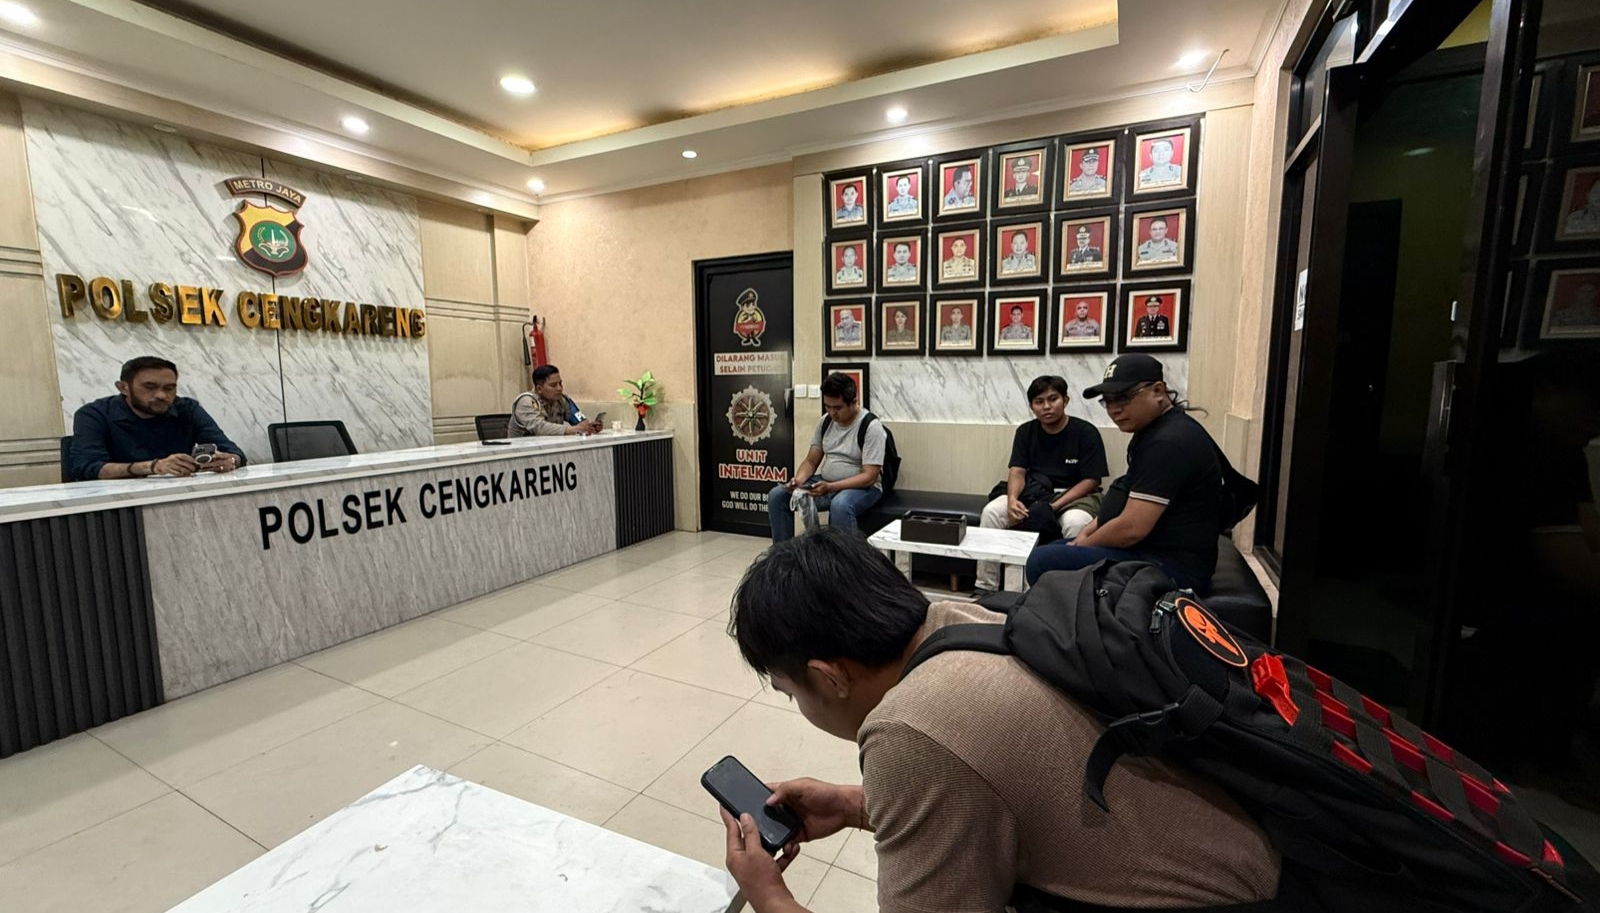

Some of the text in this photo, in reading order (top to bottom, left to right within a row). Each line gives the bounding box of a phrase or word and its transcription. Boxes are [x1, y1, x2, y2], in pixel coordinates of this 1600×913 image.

[233, 180, 301, 203] METRO JAYA
[55, 273, 426, 339] POLSEK CENGKARENG
[716, 354, 756, 363] DILARANG
[719, 365, 746, 374] SELAIN
[736, 449, 768, 463] UNIT
[719, 463, 788, 482] INTELKAM
[730, 491, 739, 500] WE
[741, 492, 748, 500] DO
[749, 492, 761, 501] OUR
[258, 461, 578, 550] POLSEK CENGKARENG
[722, 500, 734, 509] GOD
[734, 501, 749, 511] WILL
[749, 503, 758, 511] DO
